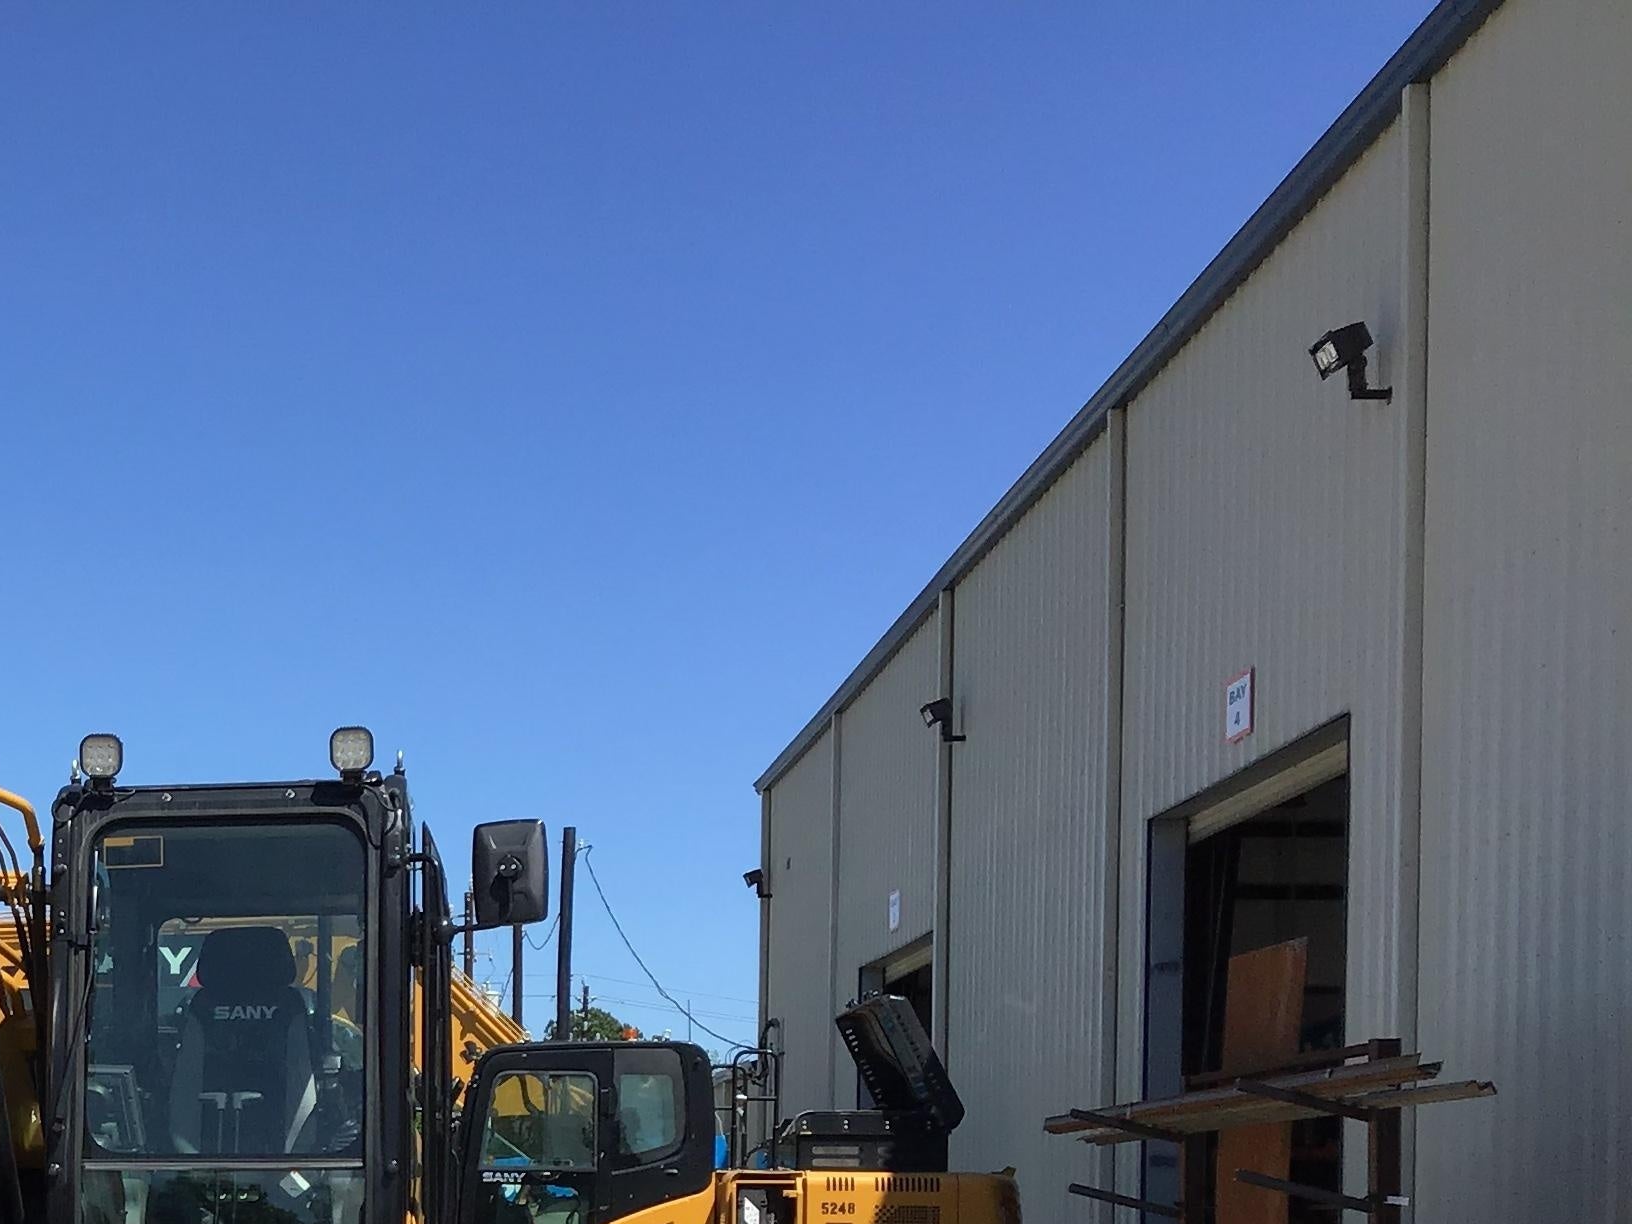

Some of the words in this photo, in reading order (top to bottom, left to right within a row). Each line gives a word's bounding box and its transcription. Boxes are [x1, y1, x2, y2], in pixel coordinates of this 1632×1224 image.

[1229, 684, 1247, 705] BAY
[214, 1005, 277, 1020] SANY
[482, 1171, 526, 1183] SANY
[821, 1202, 856, 1215] 5248
